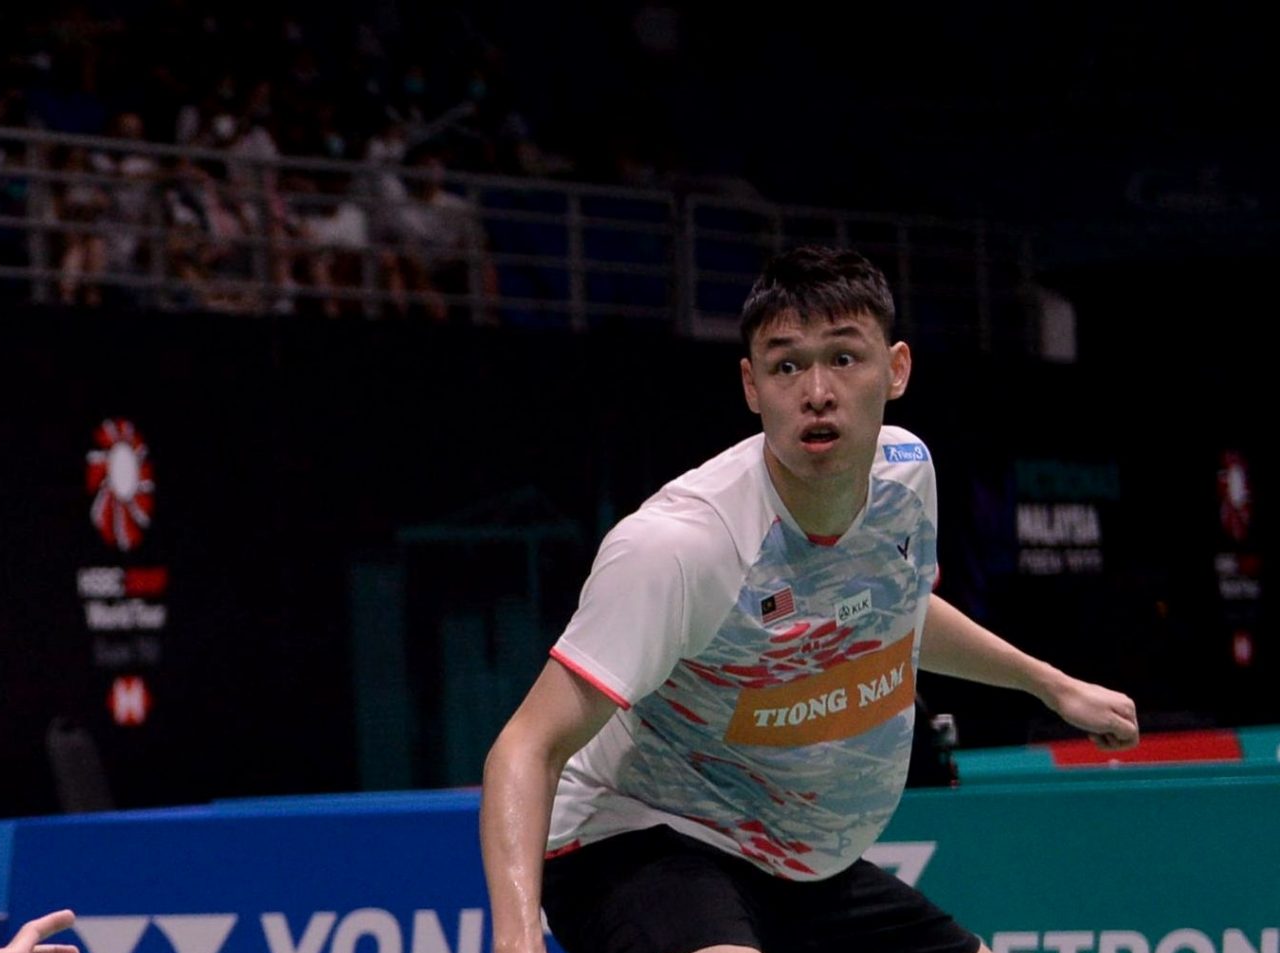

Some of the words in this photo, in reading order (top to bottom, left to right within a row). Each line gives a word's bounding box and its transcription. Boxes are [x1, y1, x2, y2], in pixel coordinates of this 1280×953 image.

[851, 600, 869, 614] KLK
[754, 688, 847, 727] TIONG
[857, 662, 905, 707] NAM
